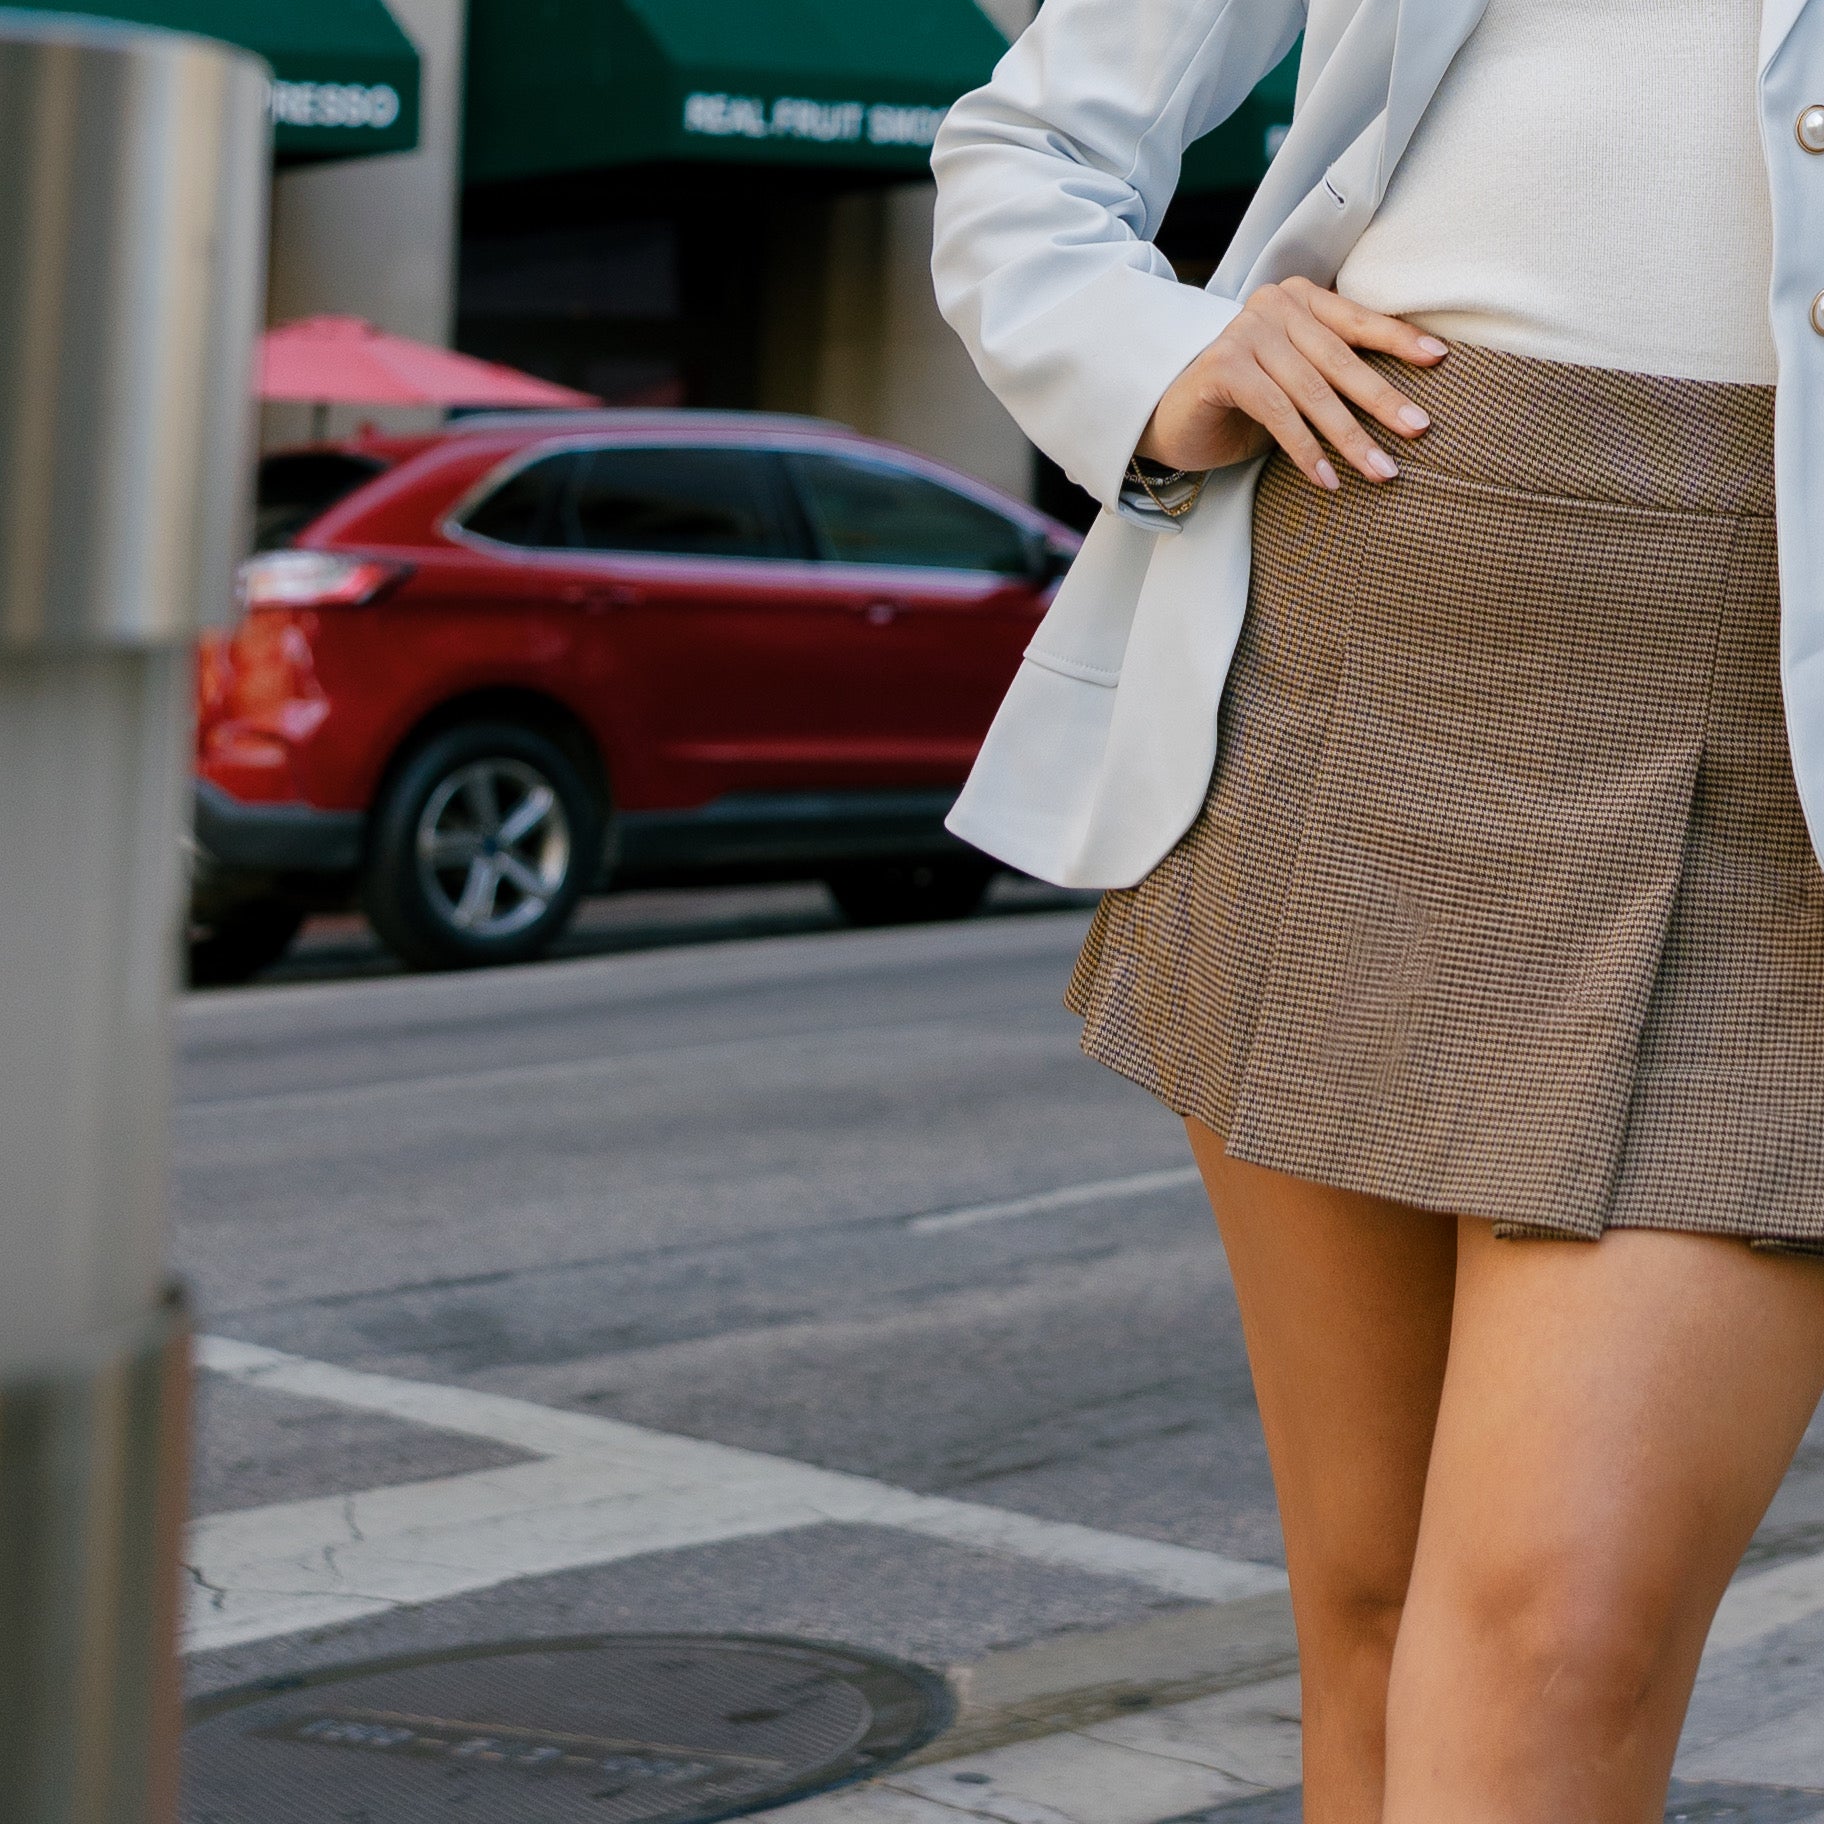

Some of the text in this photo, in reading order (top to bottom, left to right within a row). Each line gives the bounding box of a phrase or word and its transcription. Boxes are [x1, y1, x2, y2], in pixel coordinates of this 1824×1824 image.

[266, 79, 400, 129] RESSO
[684, 91, 766, 138] REAL
[768, 96, 862, 142] FRUIT
